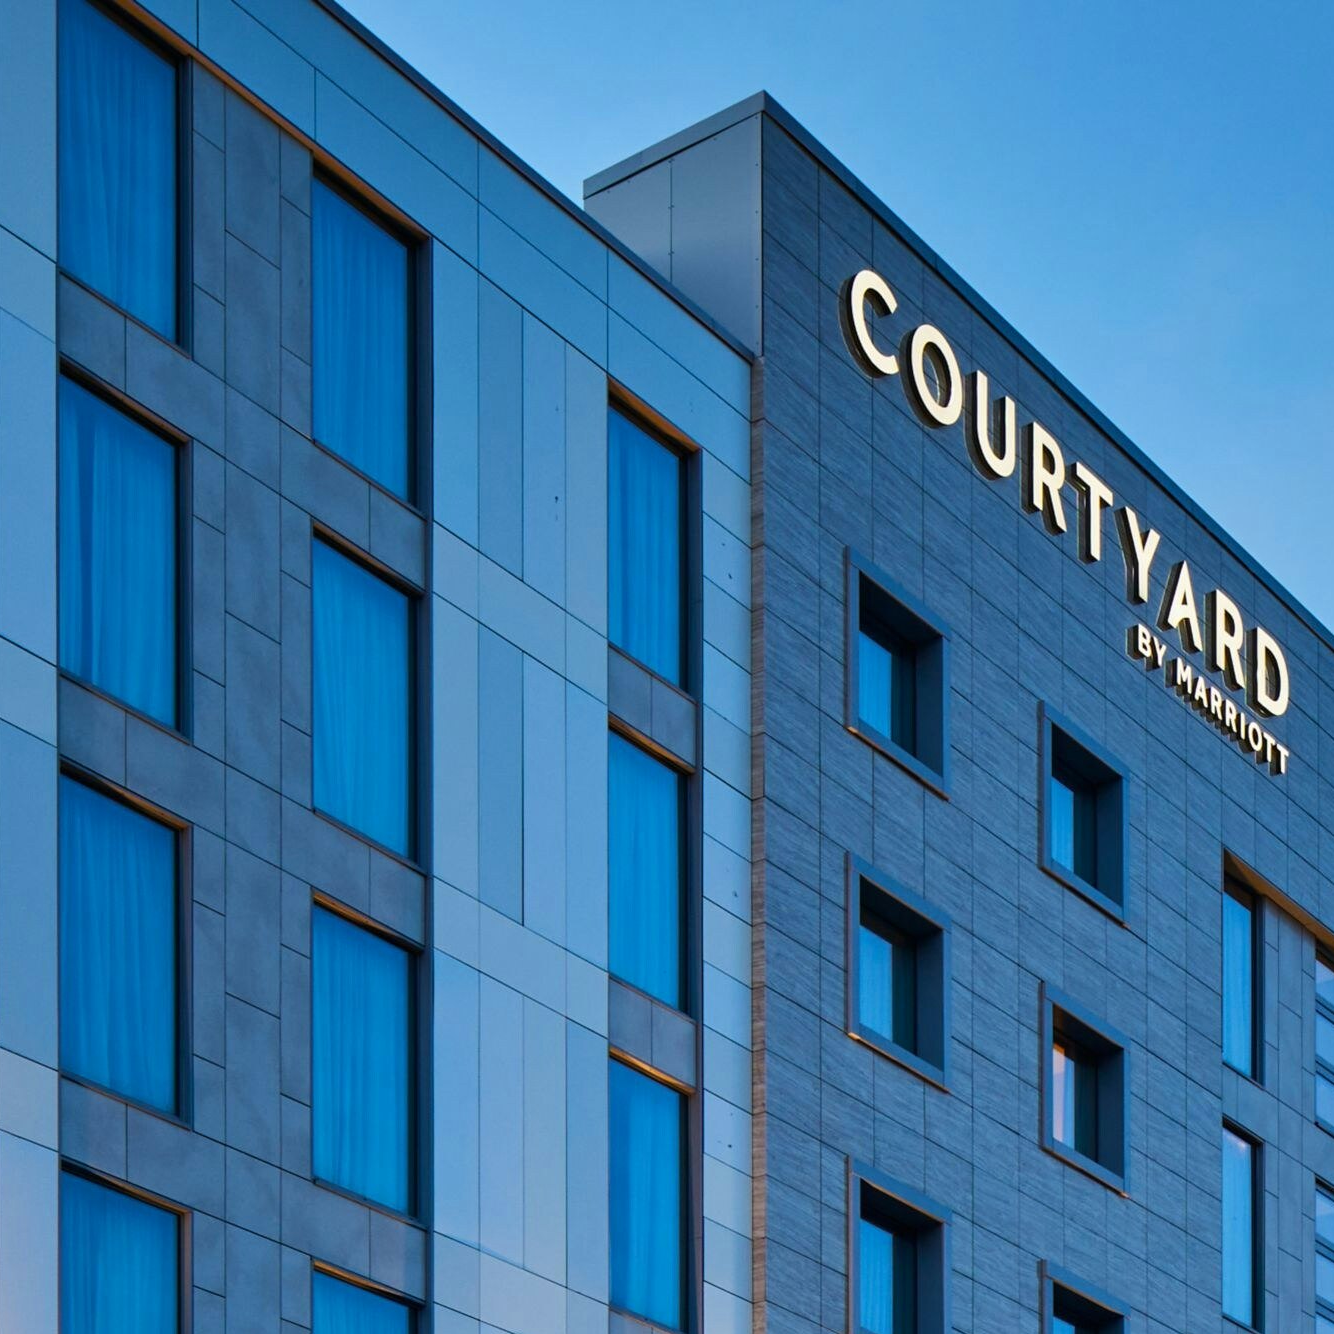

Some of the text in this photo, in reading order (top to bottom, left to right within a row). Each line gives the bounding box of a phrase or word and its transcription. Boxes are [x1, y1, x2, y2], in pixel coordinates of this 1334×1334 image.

[849, 269, 1290, 717] COURTYARD
[1133, 623, 1290, 775] BY MARRIOTT
